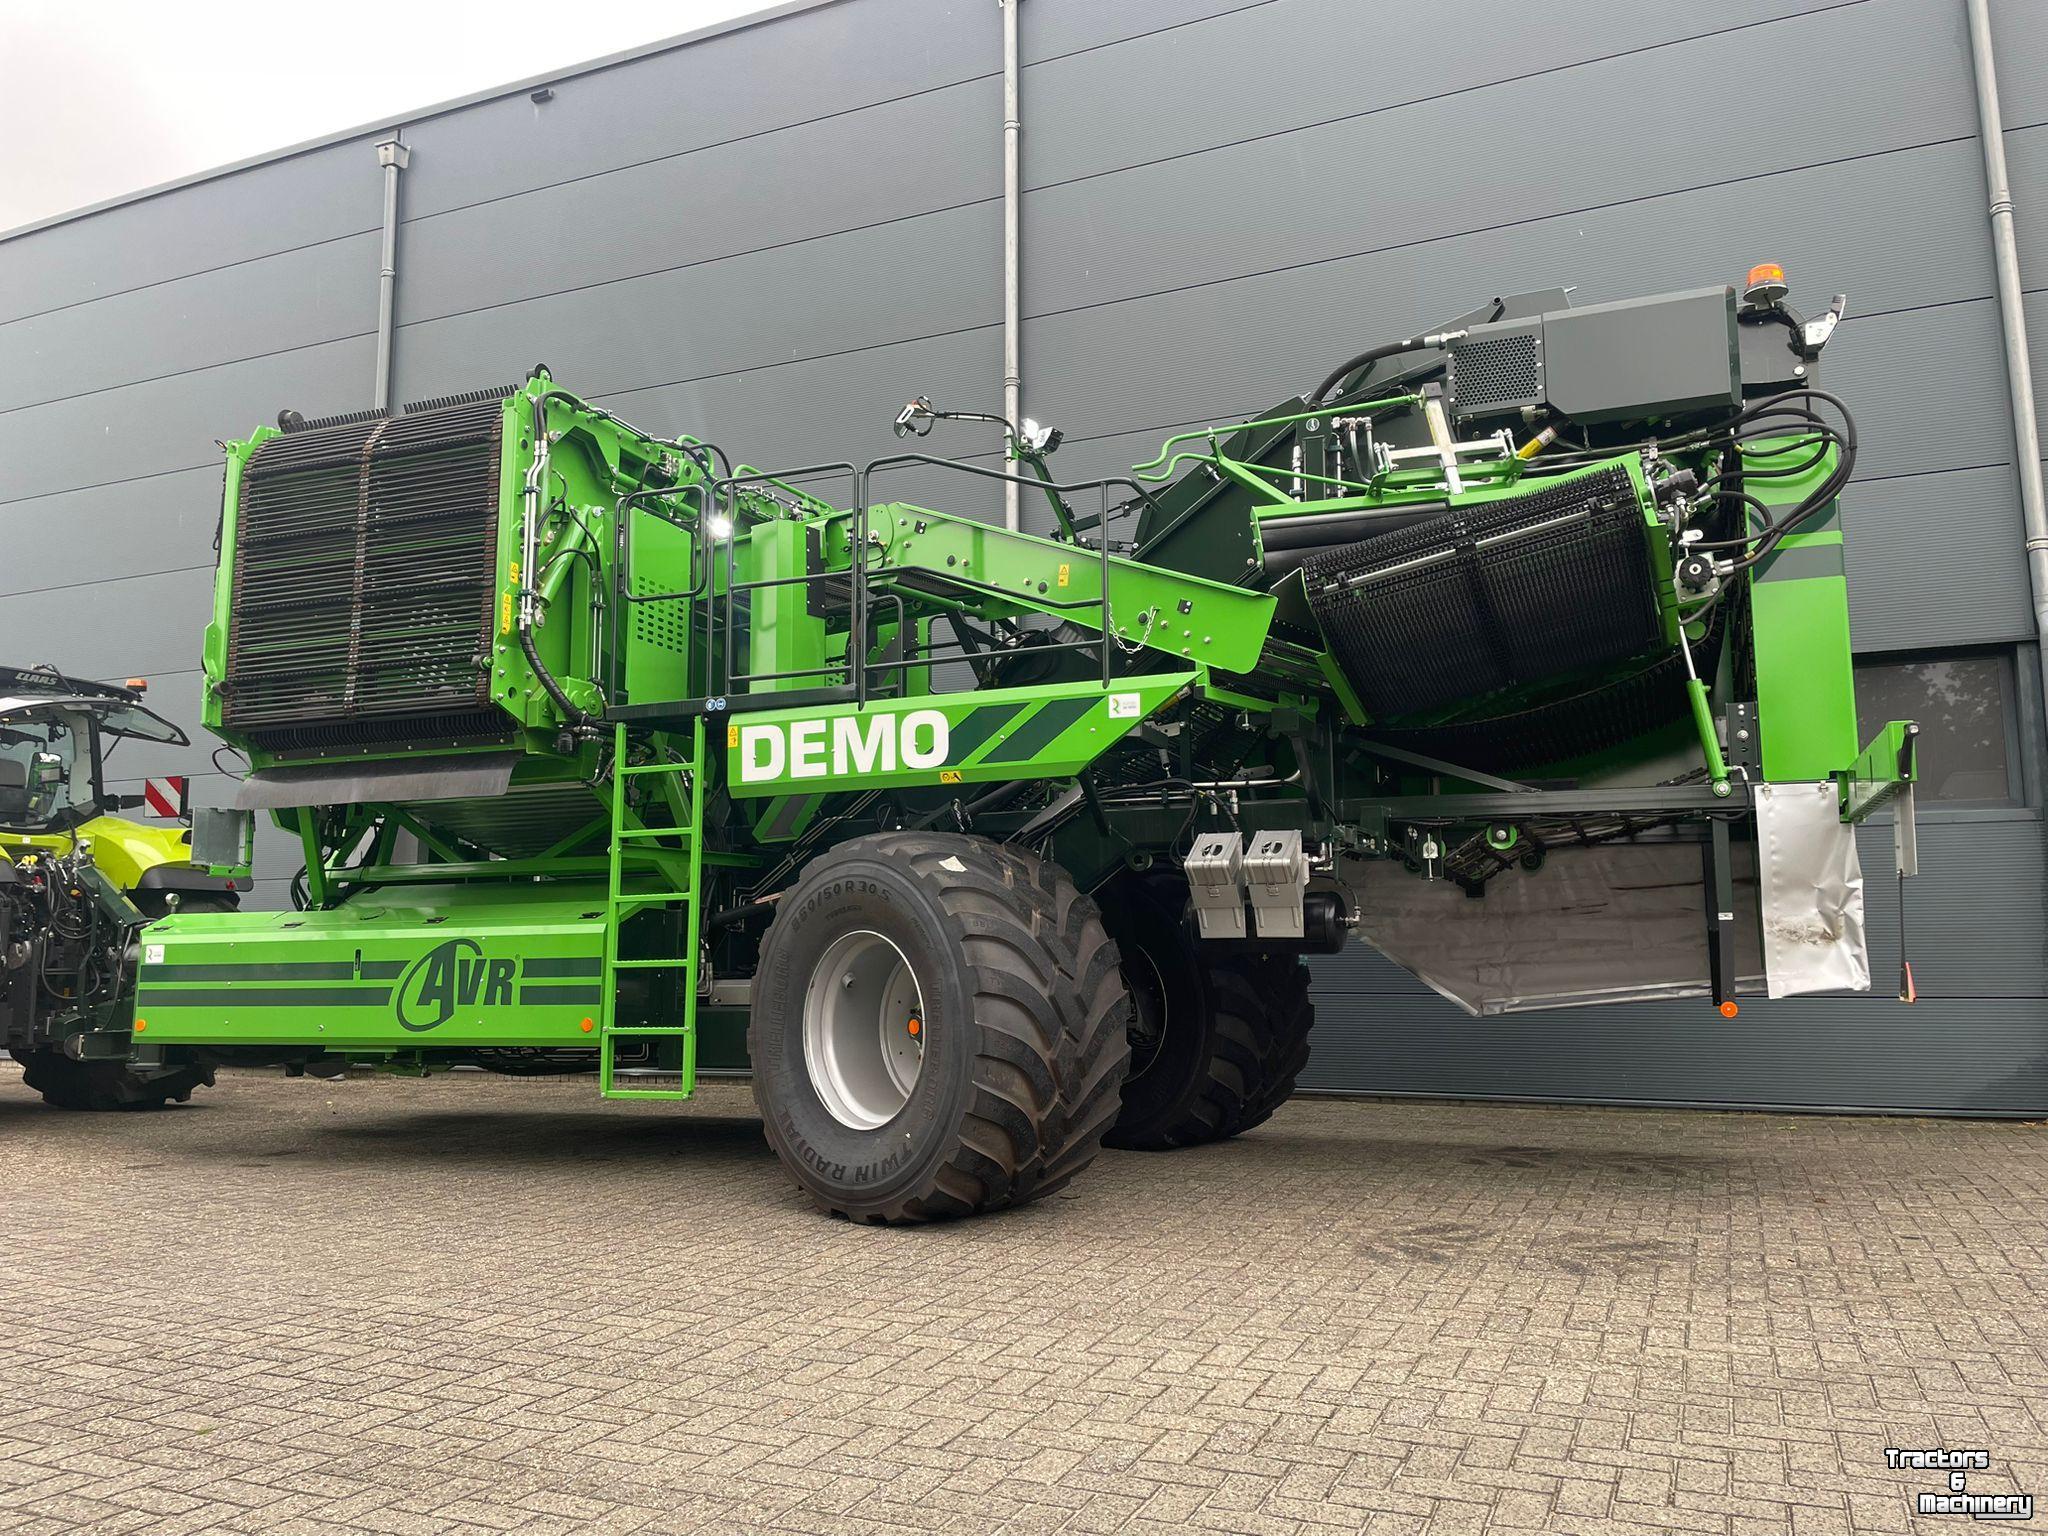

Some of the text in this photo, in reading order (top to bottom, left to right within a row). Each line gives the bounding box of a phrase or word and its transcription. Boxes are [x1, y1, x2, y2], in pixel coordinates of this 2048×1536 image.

[15, 671, 58, 686] CLAAS
[741, 709, 949, 782] DEMO
[780, 1104, 913, 1183] TWIN RADIAL
